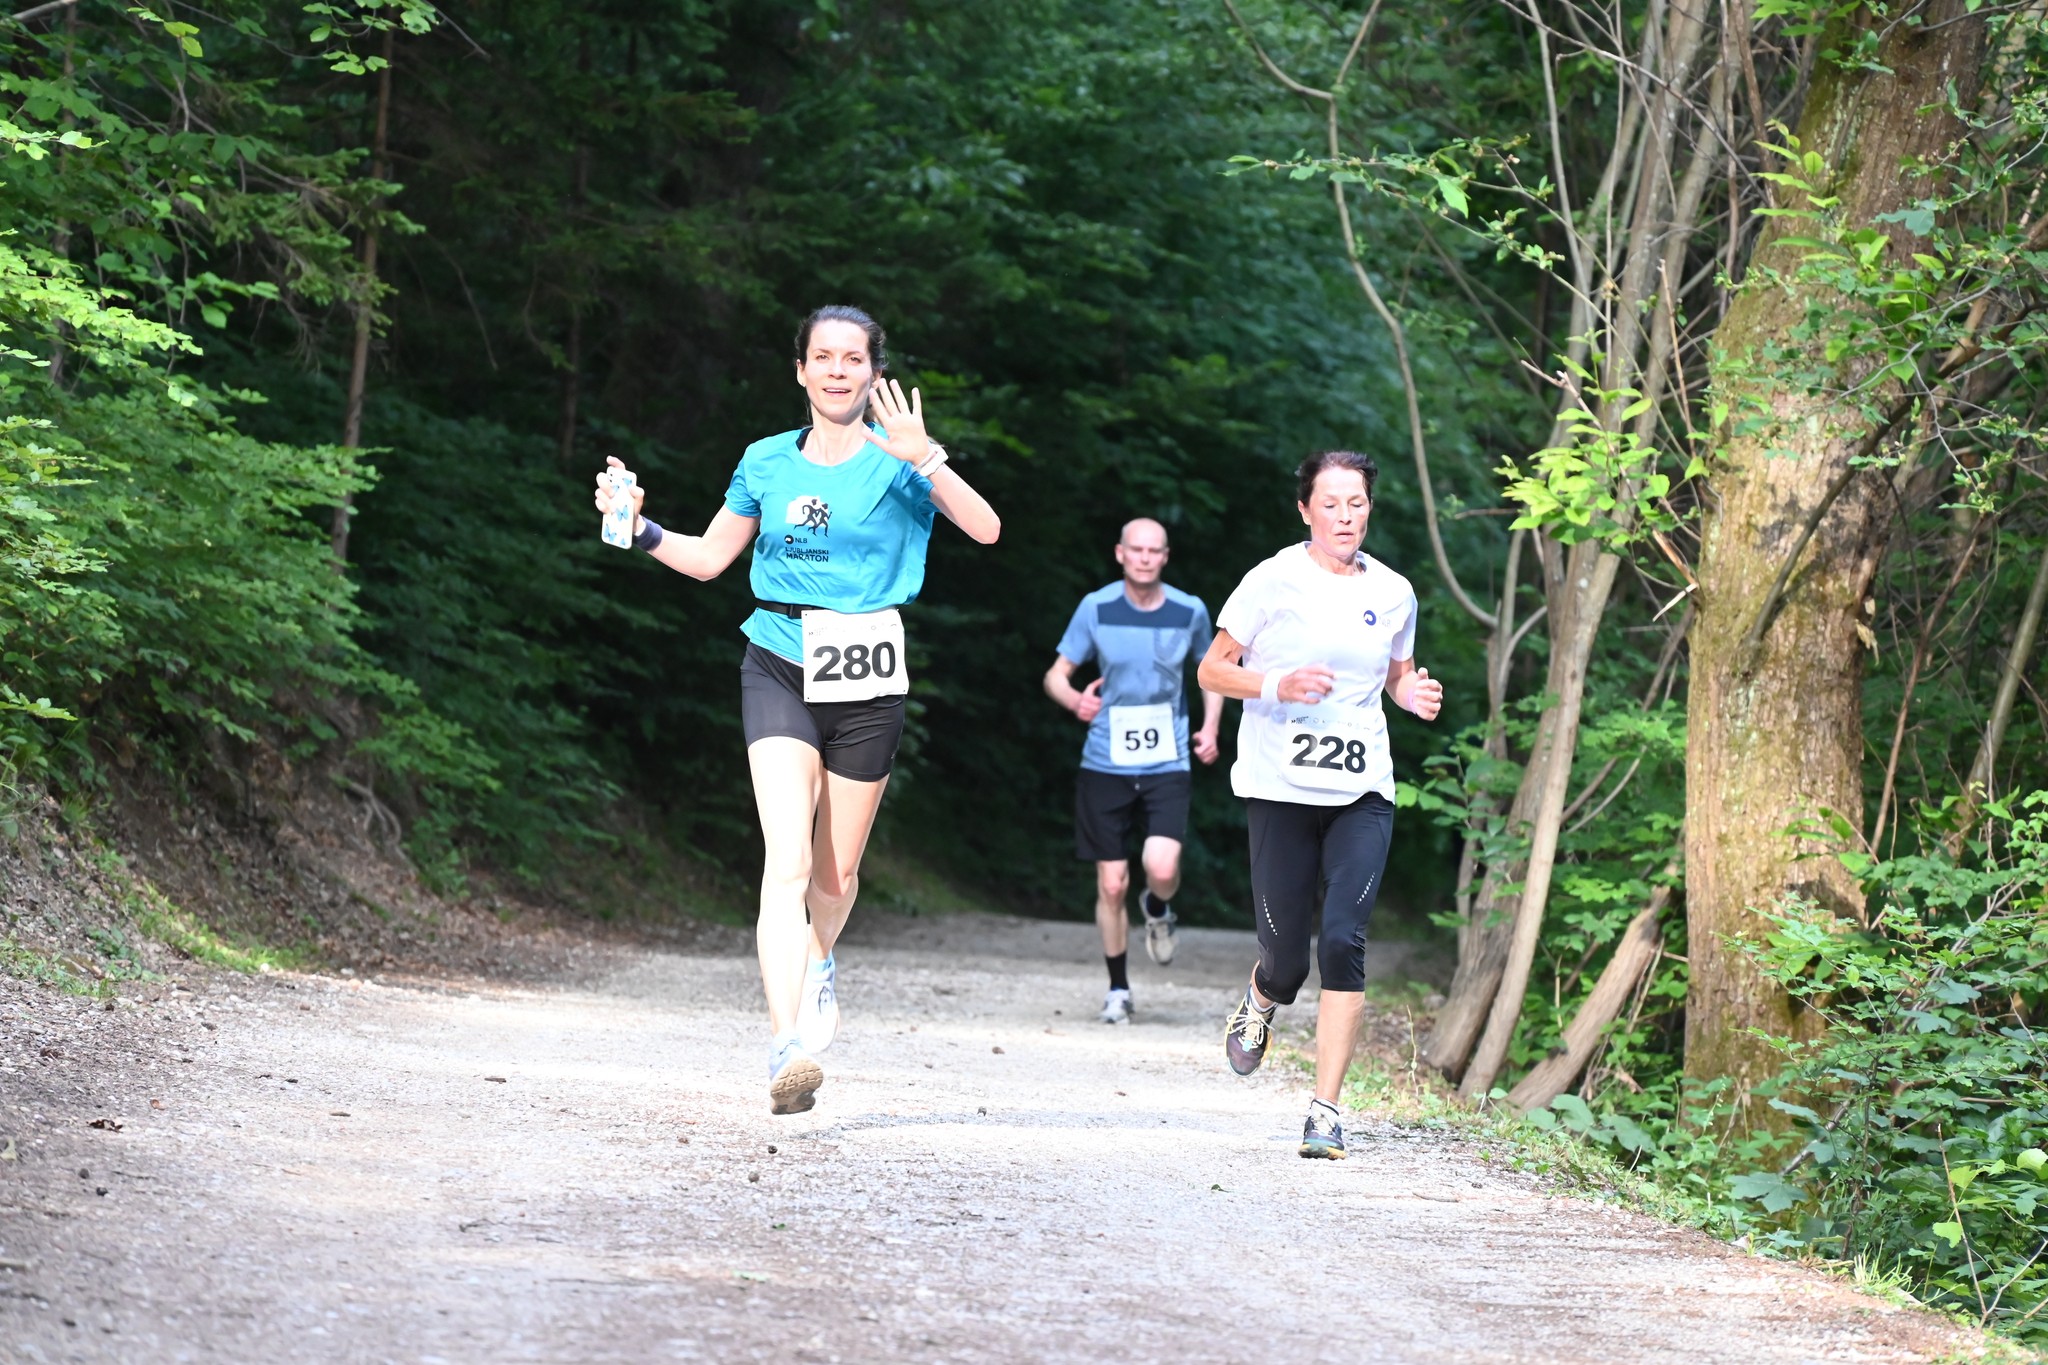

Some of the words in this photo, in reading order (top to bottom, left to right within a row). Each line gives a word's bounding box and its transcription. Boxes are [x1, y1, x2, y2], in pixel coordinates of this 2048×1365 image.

[786, 553, 829, 562] MARATON
[813, 641, 896, 682] 280
[1125, 728, 1159, 751] 59
[1289, 733, 1366, 774] 228
